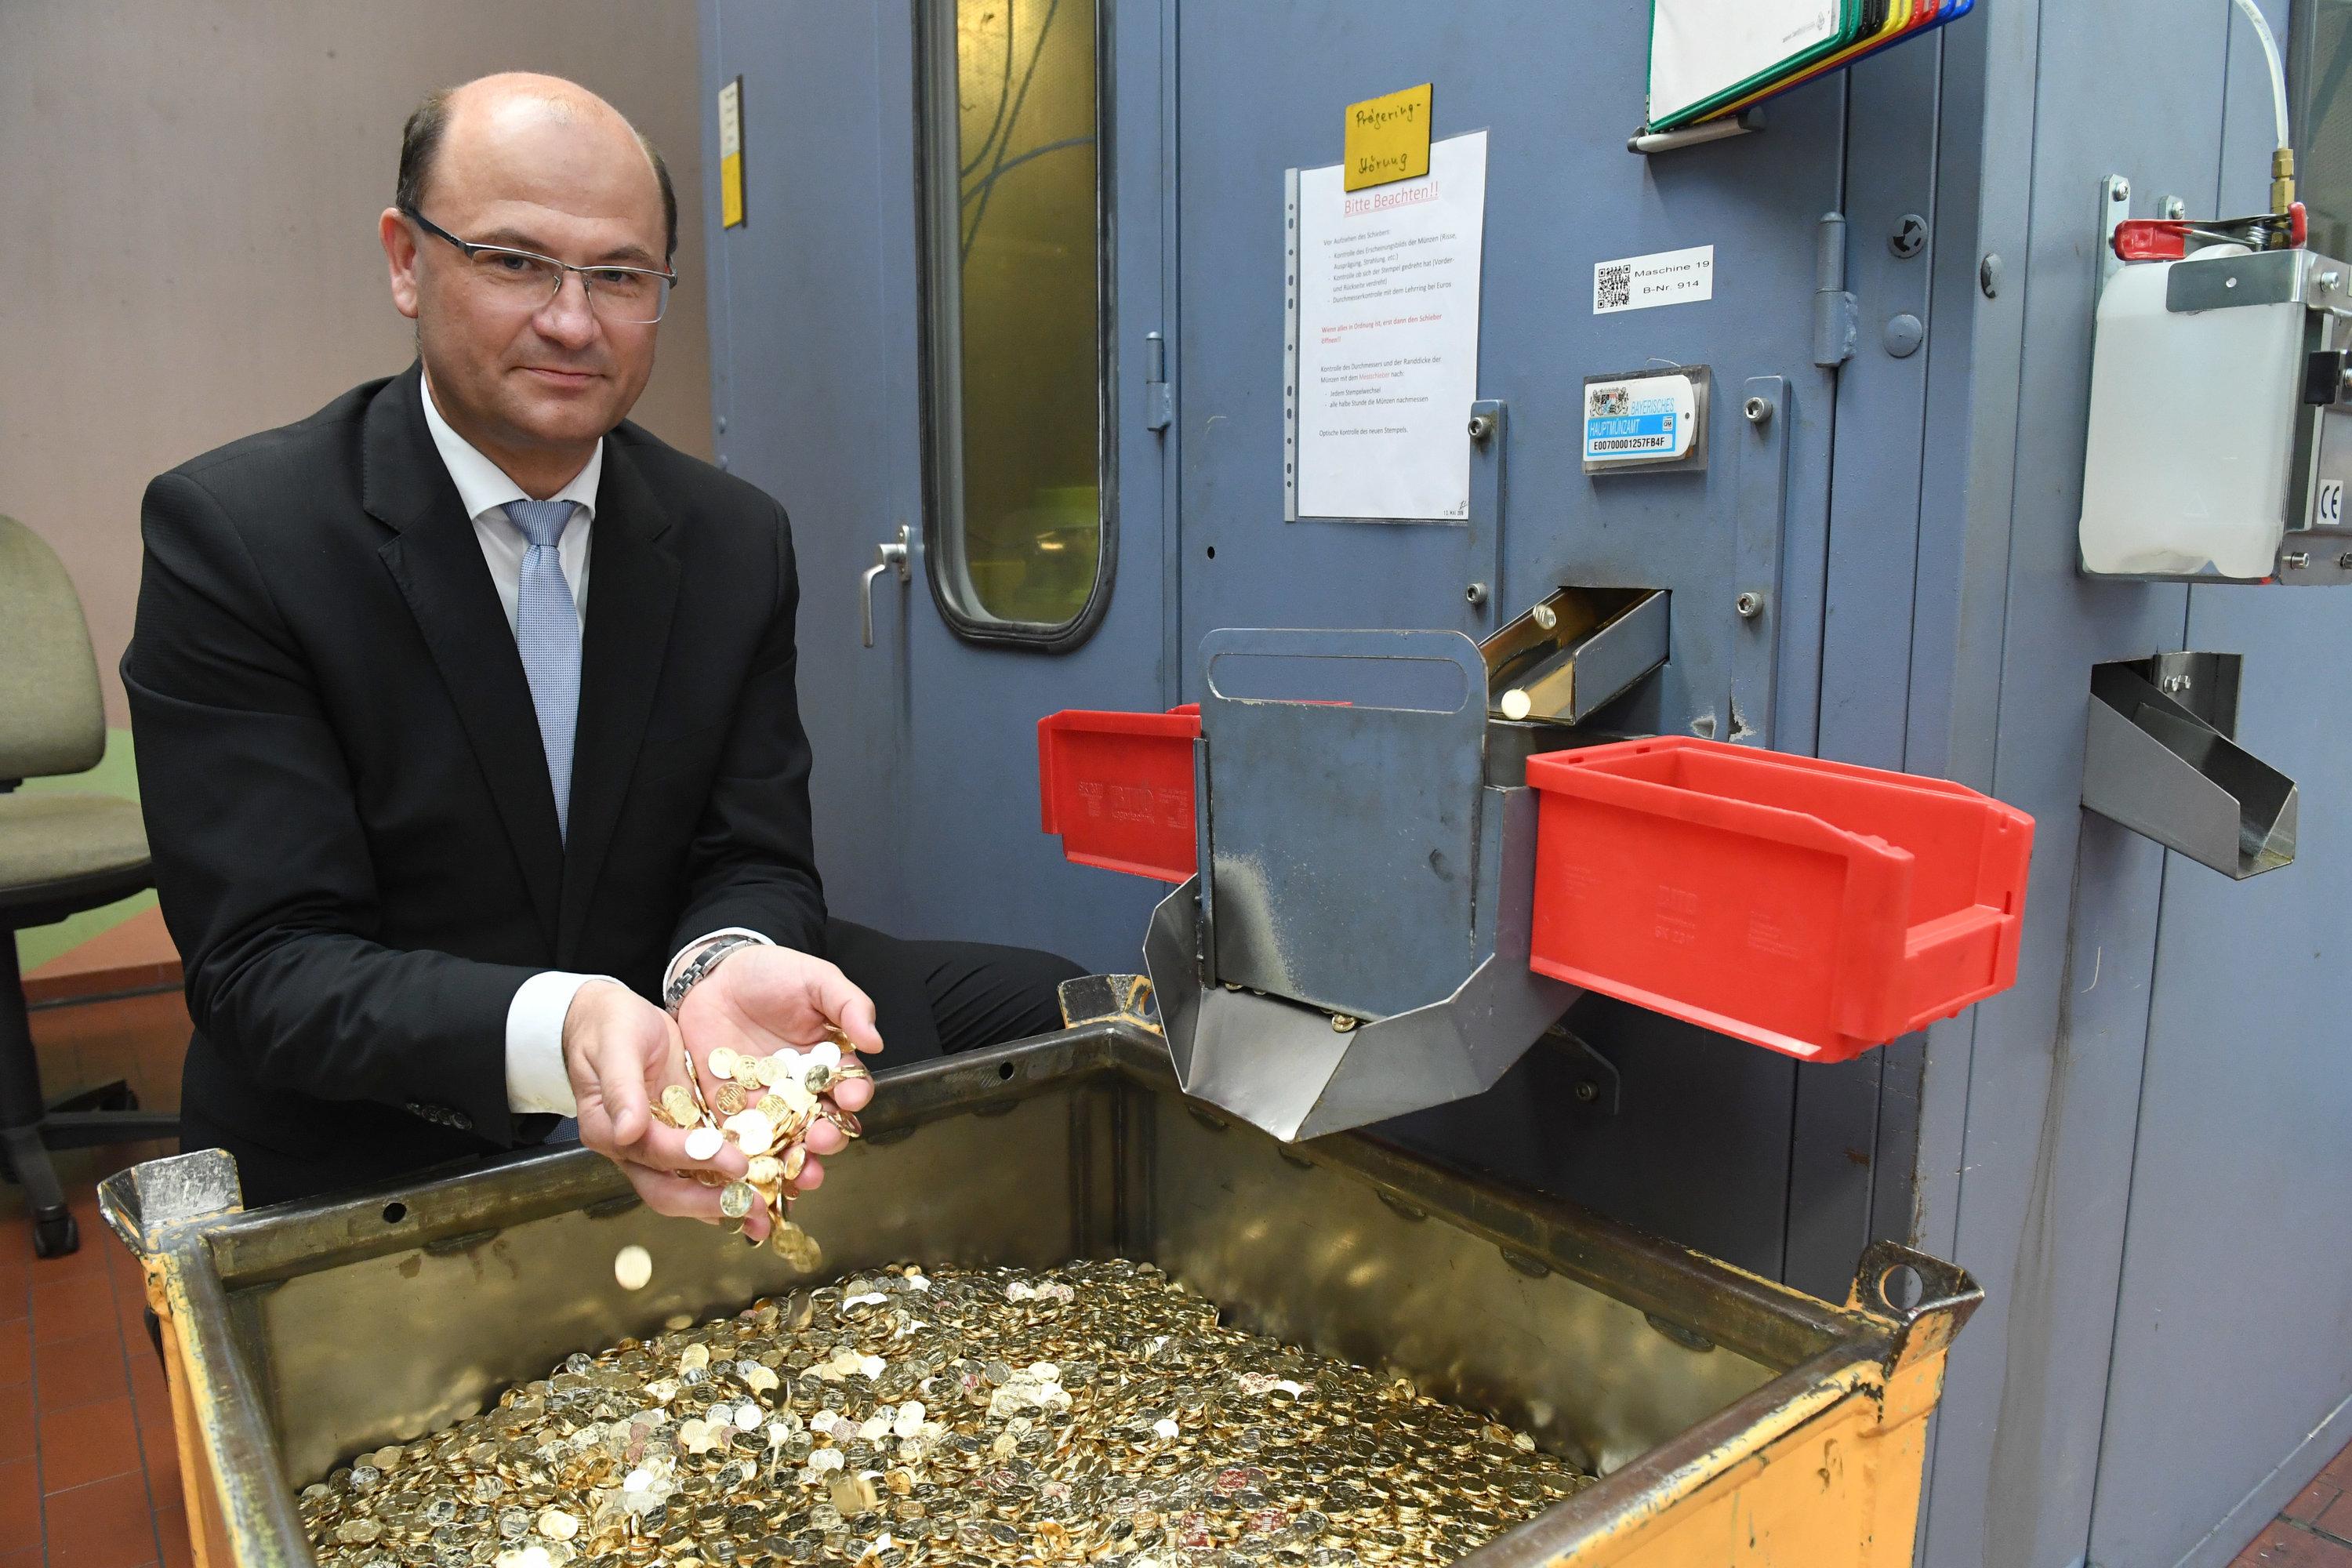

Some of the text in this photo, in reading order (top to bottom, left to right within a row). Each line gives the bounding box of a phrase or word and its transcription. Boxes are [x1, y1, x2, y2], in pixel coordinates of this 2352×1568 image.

[1345, 181, 1439, 214] Bitte Beachten!!
[1635, 264, 1691, 278] Maschine
[1643, 280, 1699, 294] B-Nr. 914
[1420, 313, 1443, 322] Schieber
[1384, 358, 1393, 367] und
[1404, 356, 1431, 365] Randdicke
[1432, 354, 1441, 363] der
[1631, 397, 1675, 416] BAYERISCHES
[1319, 429, 1339, 437] Optische
[1589, 418, 1640, 437] HAUPTMÜNZAMT
[1594, 437, 1665, 450] E00700001257FB4F
[2321, 485, 2340, 519] CE
